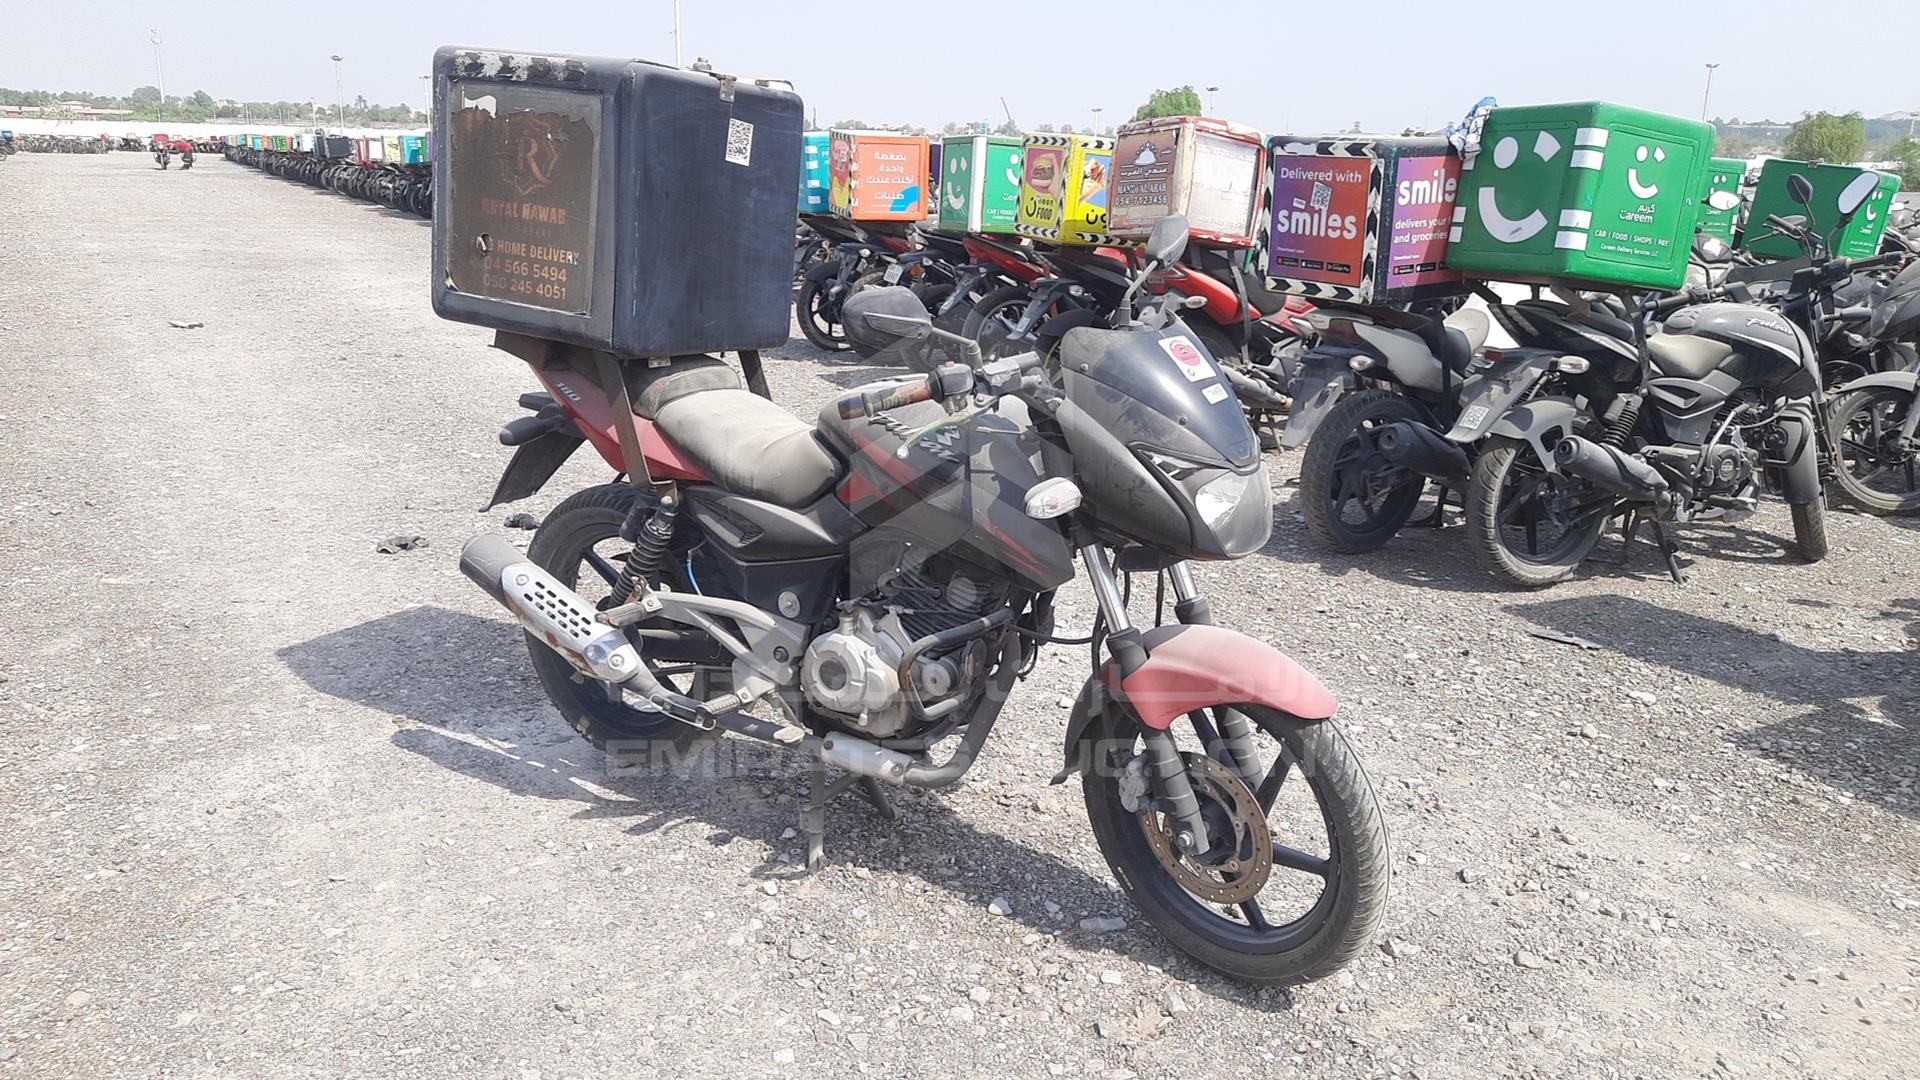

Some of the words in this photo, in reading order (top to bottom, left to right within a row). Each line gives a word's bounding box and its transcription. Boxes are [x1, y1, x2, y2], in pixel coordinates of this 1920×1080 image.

[1280, 167, 1333, 181] Delivered
[1335, 170, 1363, 183] with
[522, 202, 567, 225] NAWAB
[1619, 209, 1654, 224] Careem
[1637, 203, 1656, 214] كريم
[1277, 207, 1357, 240] smiles
[1395, 217, 1428, 230] delivers
[1428, 217, 1447, 229] your
[1393, 232, 1410, 244] and
[1411, 230, 1448, 245] groceries
[1594, 229, 1607, 238] CAR
[1612, 231, 1628, 241] FOOD
[1633, 235, 1653, 245] SHOPS
[1657, 239, 1669, 247] PAY
[497, 239, 528, 257] HOME
[530, 244, 580, 266] DELIVERY
[505, 260, 529, 276] 566
[533, 264, 568, 283] 5494
[510, 277, 533, 295] 245
[536, 282, 567, 300] 4051
